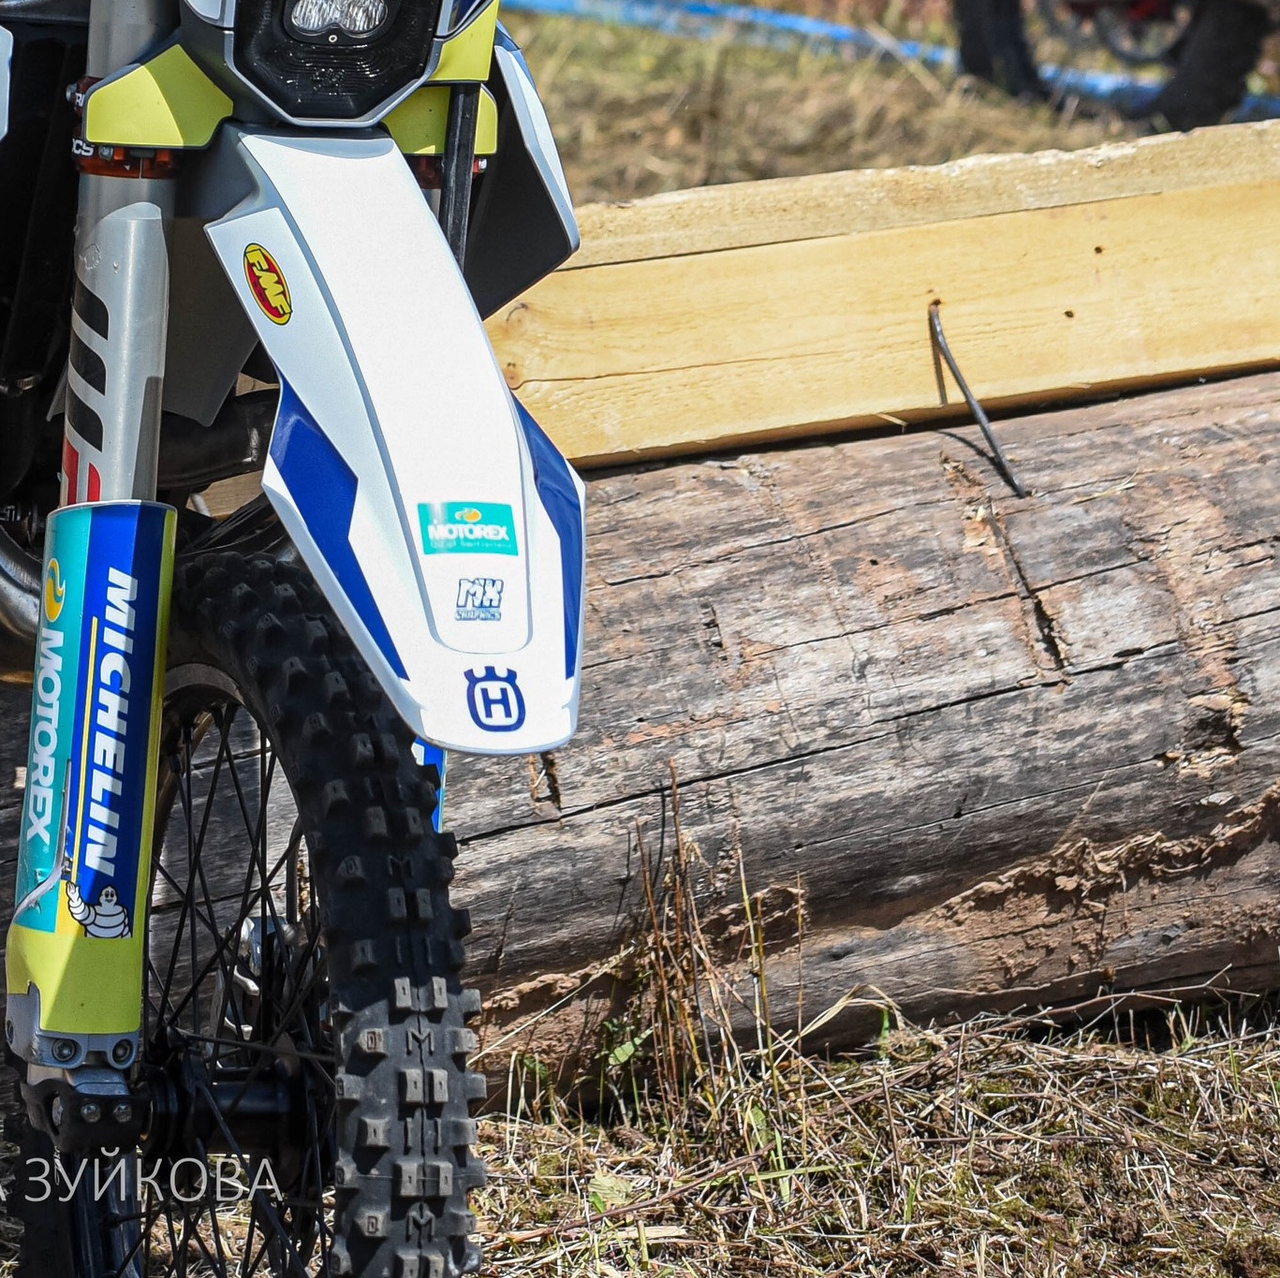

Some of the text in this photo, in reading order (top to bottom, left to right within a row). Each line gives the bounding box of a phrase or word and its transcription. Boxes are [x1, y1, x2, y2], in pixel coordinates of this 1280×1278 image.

[246, 249, 292, 315] FMF
[428, 524, 509, 541] MOTOREX
[456, 578, 504, 608] MX
[26, 626, 64, 842] MOTOREX
[84, 566, 138, 878] MICHELIN
